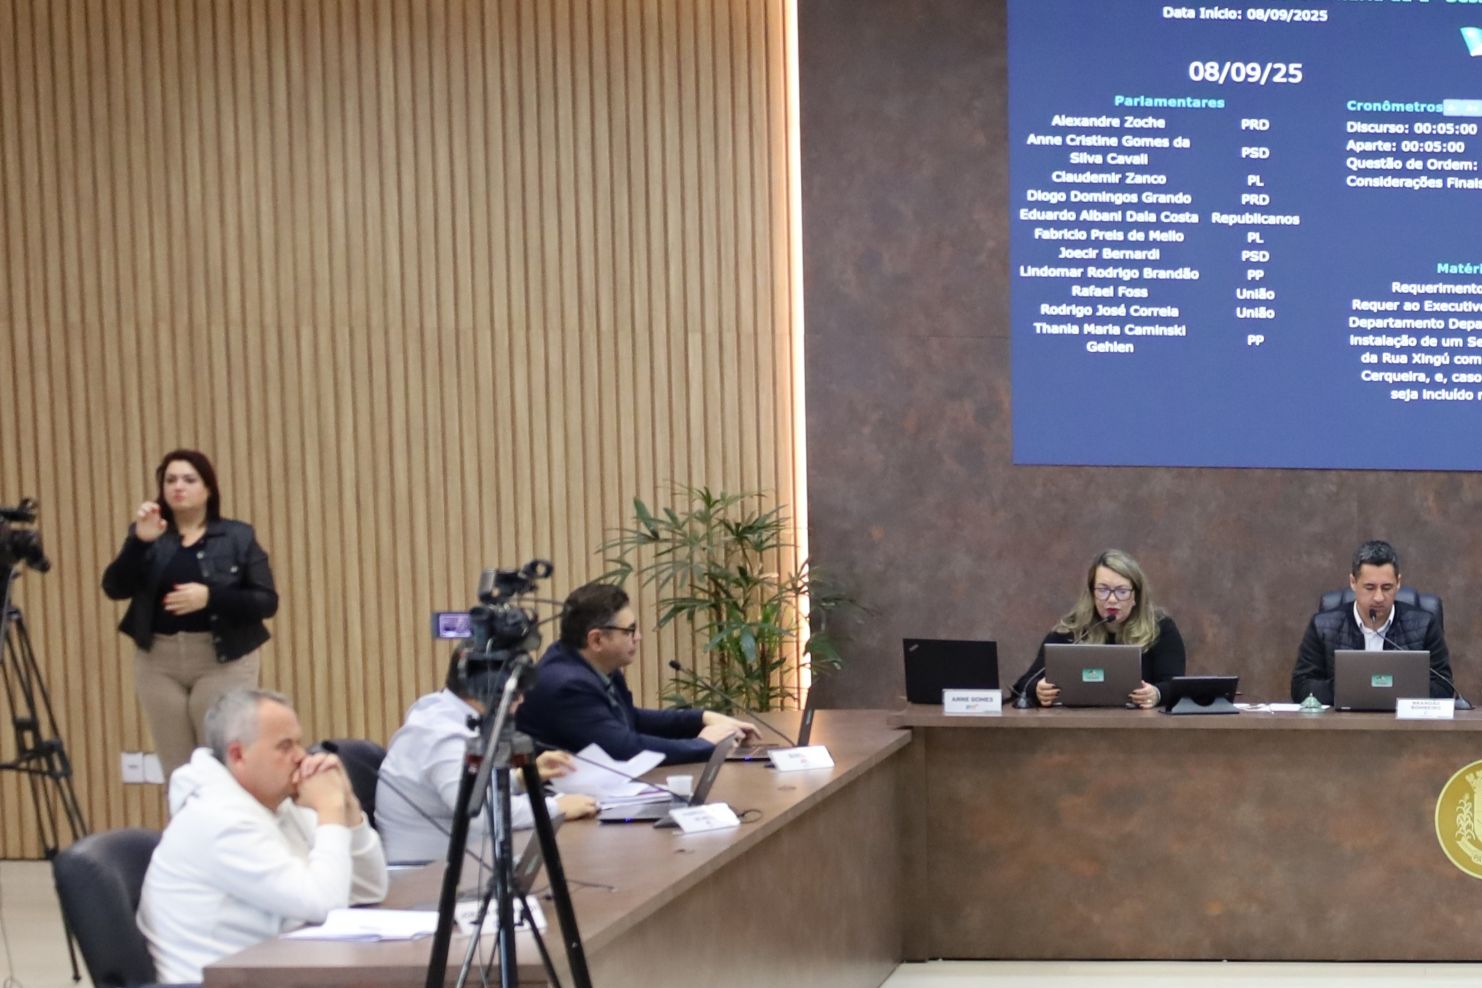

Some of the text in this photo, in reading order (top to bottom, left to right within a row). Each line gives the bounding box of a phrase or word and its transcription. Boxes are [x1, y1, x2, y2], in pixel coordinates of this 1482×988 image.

[1162, 6, 1328, 22] Data Início: 08/09/2025
[1189, 61, 1303, 85] 08/09/25
[1114, 95, 1225, 108] Parlamentares
[1347, 99, 1443, 113] Cronômetros
[1051, 114, 1166, 128] Alexandre Zoche
[1241, 118, 1270, 130] PRD
[1346, 121, 1478, 135] Discurso: 00:05:00
[1026, 133, 1190, 148] Anne Cristine Gomes da
[1346, 139, 1465, 153] Aparte: 00:05:00
[1069, 152, 1103, 164] Silva
[1241, 146, 1270, 159] PSD
[1346, 157, 1403, 171] Questão
[1405, 158, 1423, 170] de
[1426, 158, 1478, 170] Ordem:
[1051, 170, 1167, 184] Claudemir Zanco
[1247, 174, 1264, 186] PL
[1346, 175, 1443, 190] Considerações
[1026, 189, 1192, 205] Diogo Domingos Grando
[1241, 193, 1270, 205] PRD
[1019, 208, 1199, 223] Eduardo Albani Dala Costa
[1211, 212, 1300, 226] Republicanos
[1127, 229, 1145, 241] de
[1247, 231, 1264, 243] PL
[1058, 247, 1160, 260] Joecir Bernardi
[1241, 250, 1270, 262] PSD
[1019, 265, 1200, 281] Lindomar Rodrigo Brandão
[1247, 269, 1264, 280] PP
[1071, 285, 1148, 298] Rafael Foss
[1236, 287, 1275, 300] União
[1040, 303, 1179, 318] Rodrigo José Correia
[1236, 306, 1275, 319] União
[1352, 299, 1400, 313] Requer
[1403, 301, 1420, 311] ao
[1083, 323, 1121, 335] Maria
[1124, 324, 1186, 336] Caminski
[1348, 316, 1445, 330] Departamento
[1247, 334, 1264, 346] PP
[1420, 335, 1438, 347] de
[1441, 338, 1463, 347] um
[1086, 341, 1134, 353] Gehlen
[1360, 352, 1378, 363] da
[1382, 352, 1408, 364] Rua
[1453, 355, 1482, 365] com
[1361, 370, 1430, 384] Cerqueira,
[1434, 373, 1448, 384] e,
[1451, 373, 1482, 383] caso
[1390, 388, 1419, 402] seja
[1422, 388, 1474, 400] incluído
